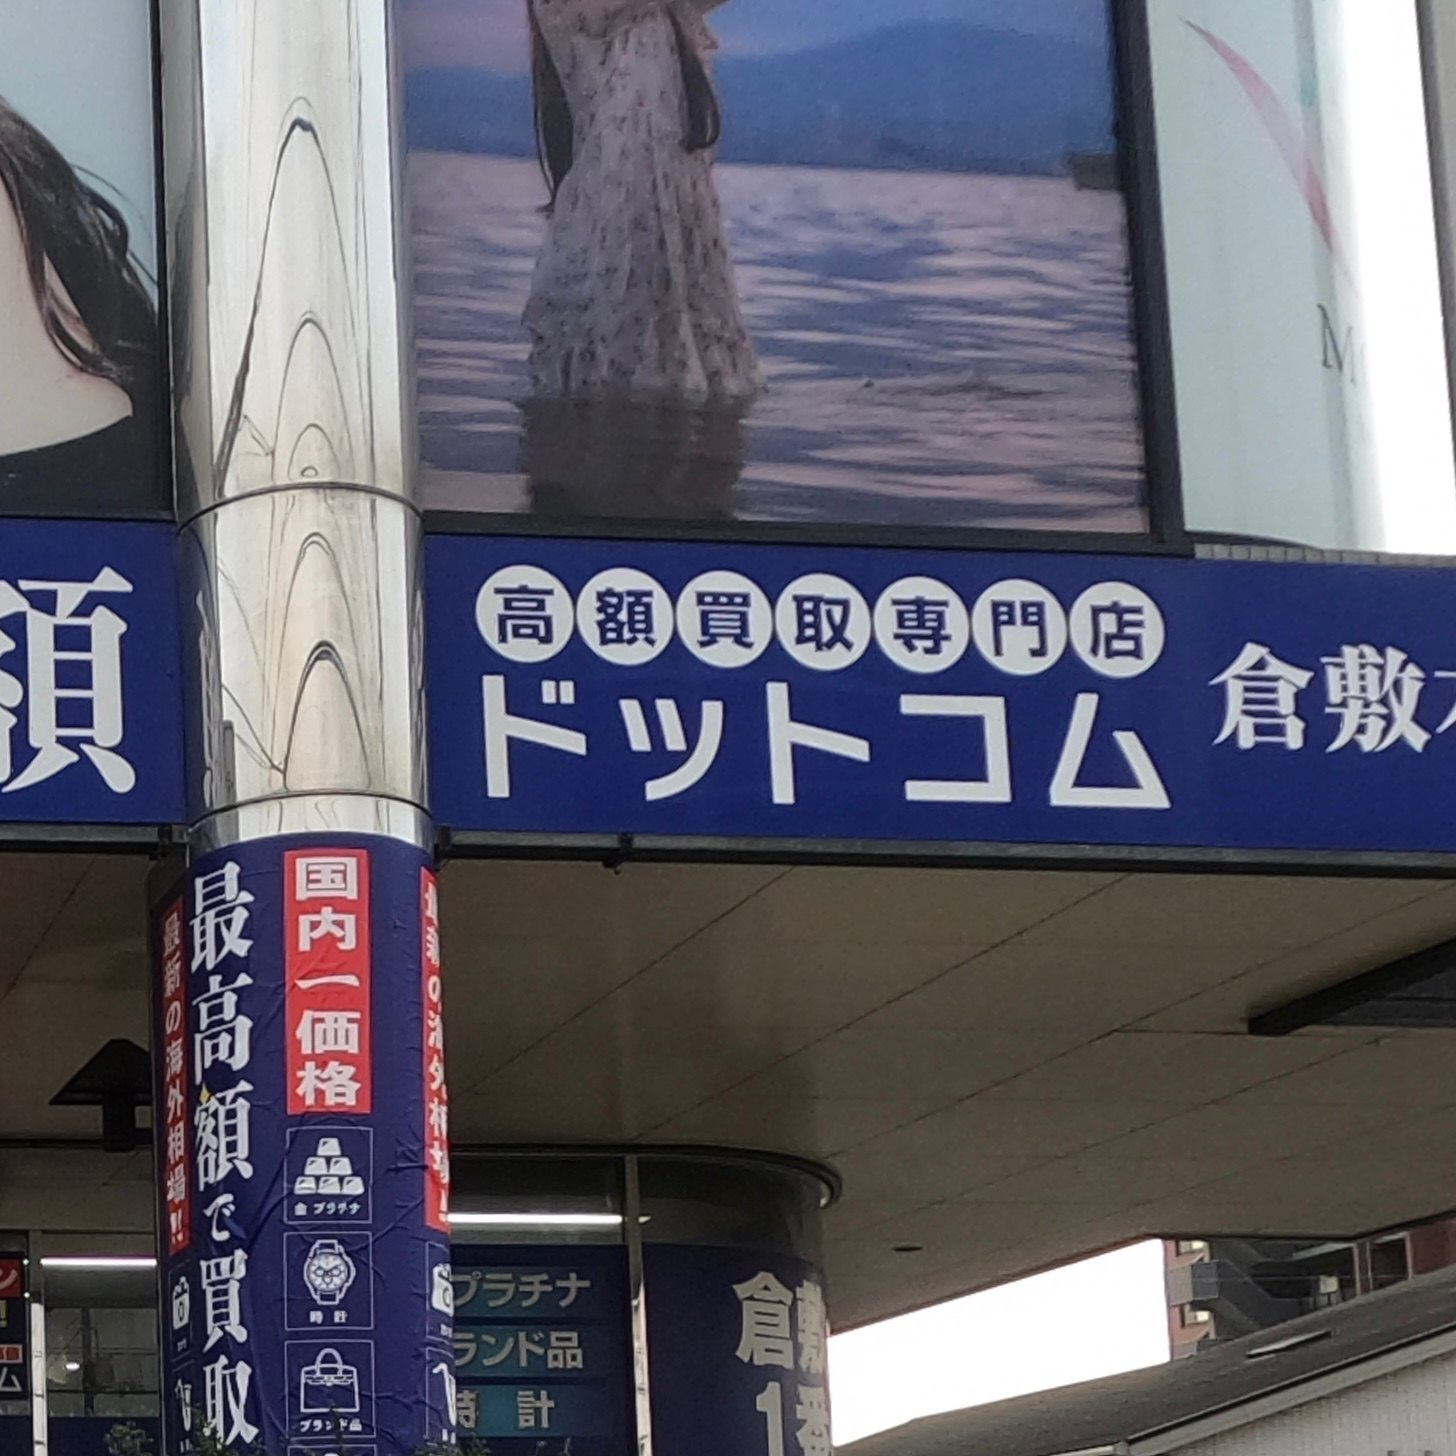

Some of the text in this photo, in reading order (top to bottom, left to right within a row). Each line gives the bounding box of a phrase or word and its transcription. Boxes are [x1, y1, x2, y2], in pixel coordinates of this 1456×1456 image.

[490, 580, 1148, 663] 高額買取専門店
[481, 673, 1172, 810] ドットコム
[1207, 640, 1456, 754] 倉敷
[294, 856, 362, 1107] 国内一価格
